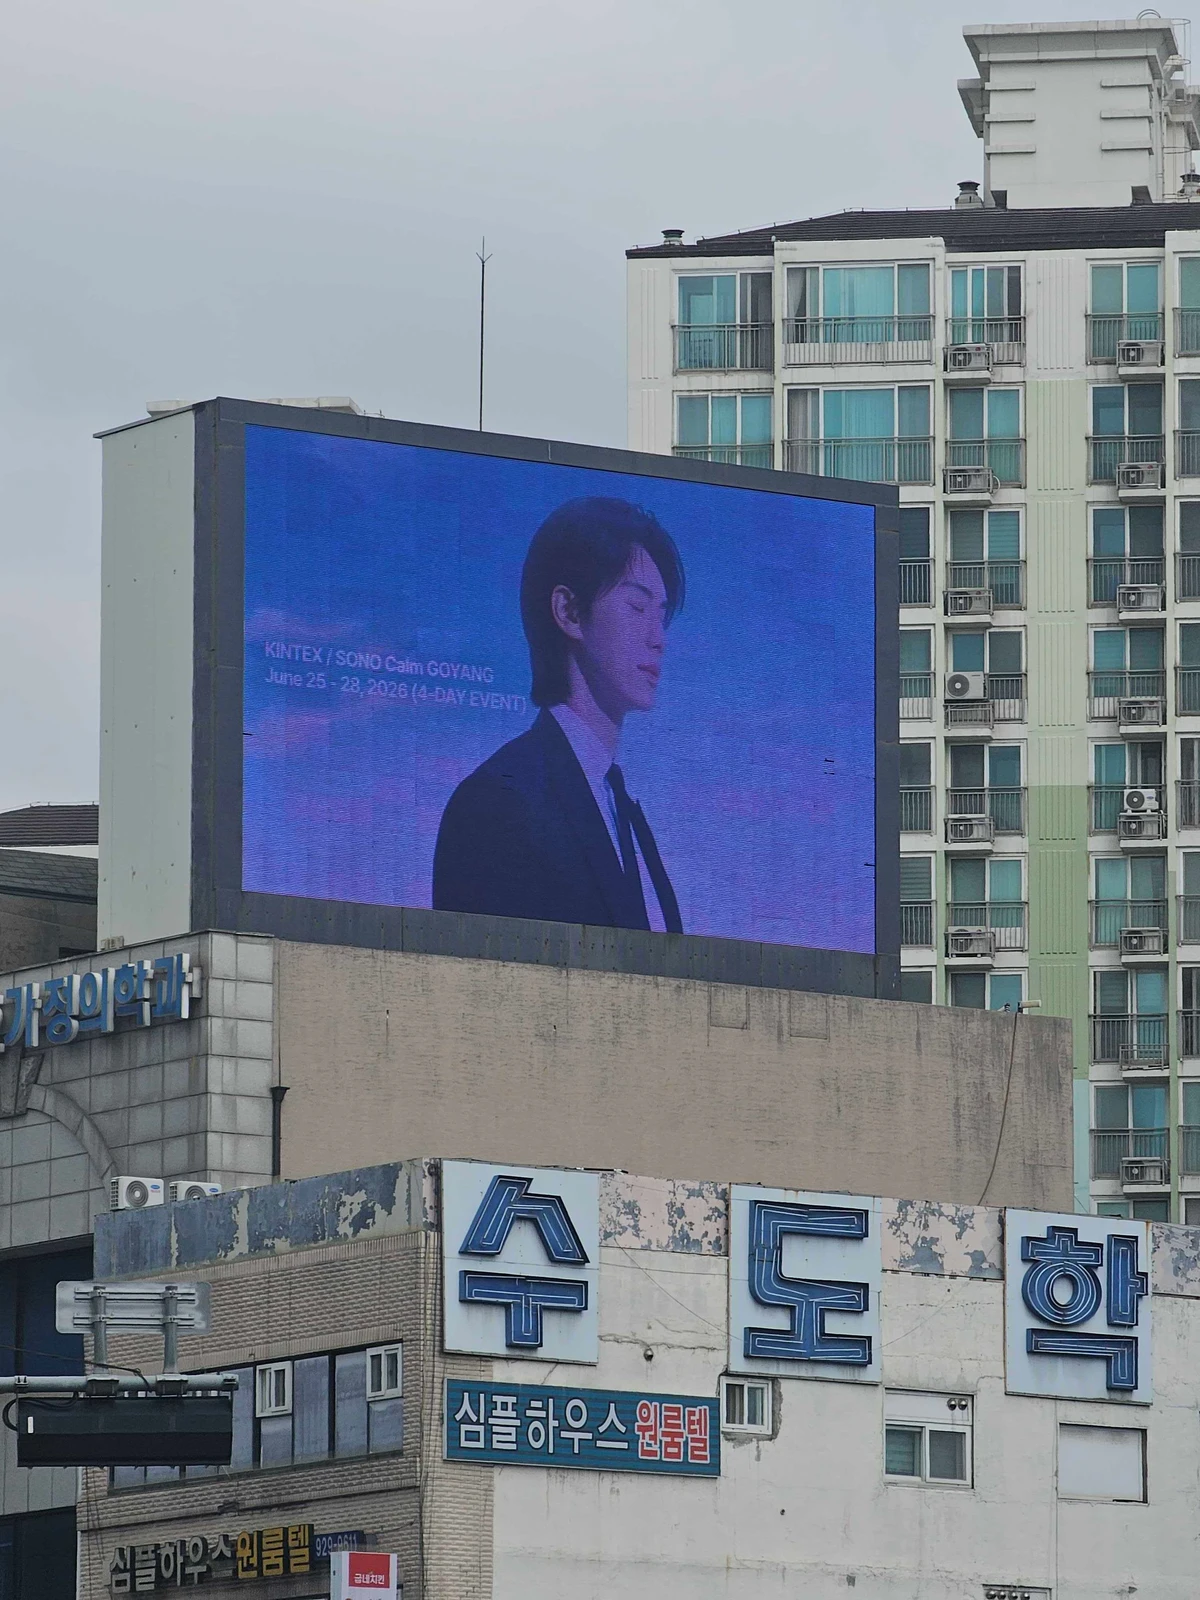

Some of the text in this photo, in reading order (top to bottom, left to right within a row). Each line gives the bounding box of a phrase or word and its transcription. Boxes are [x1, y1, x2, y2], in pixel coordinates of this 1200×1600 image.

[264, 641, 323, 663] KINTEX
[326, 648, 334, 666] /
[336, 650, 382, 669] SONO
[427, 660, 495, 683] GOYANG
[265, 668, 303, 687] June
[306, 672, 327, 689] 25
[367, 679, 408, 699] 2026
[411, 682, 467, 705] (4-DAY
[469, 690, 527, 714] EVENT)
[4, 953, 192, 1047] 가정의학과
[454, 1392, 710, 1463] 심플하우스 원룸텔
[110, 1534, 233, 1594] 심플하우스
[235, 1524, 312, 1579] 원룸텔
